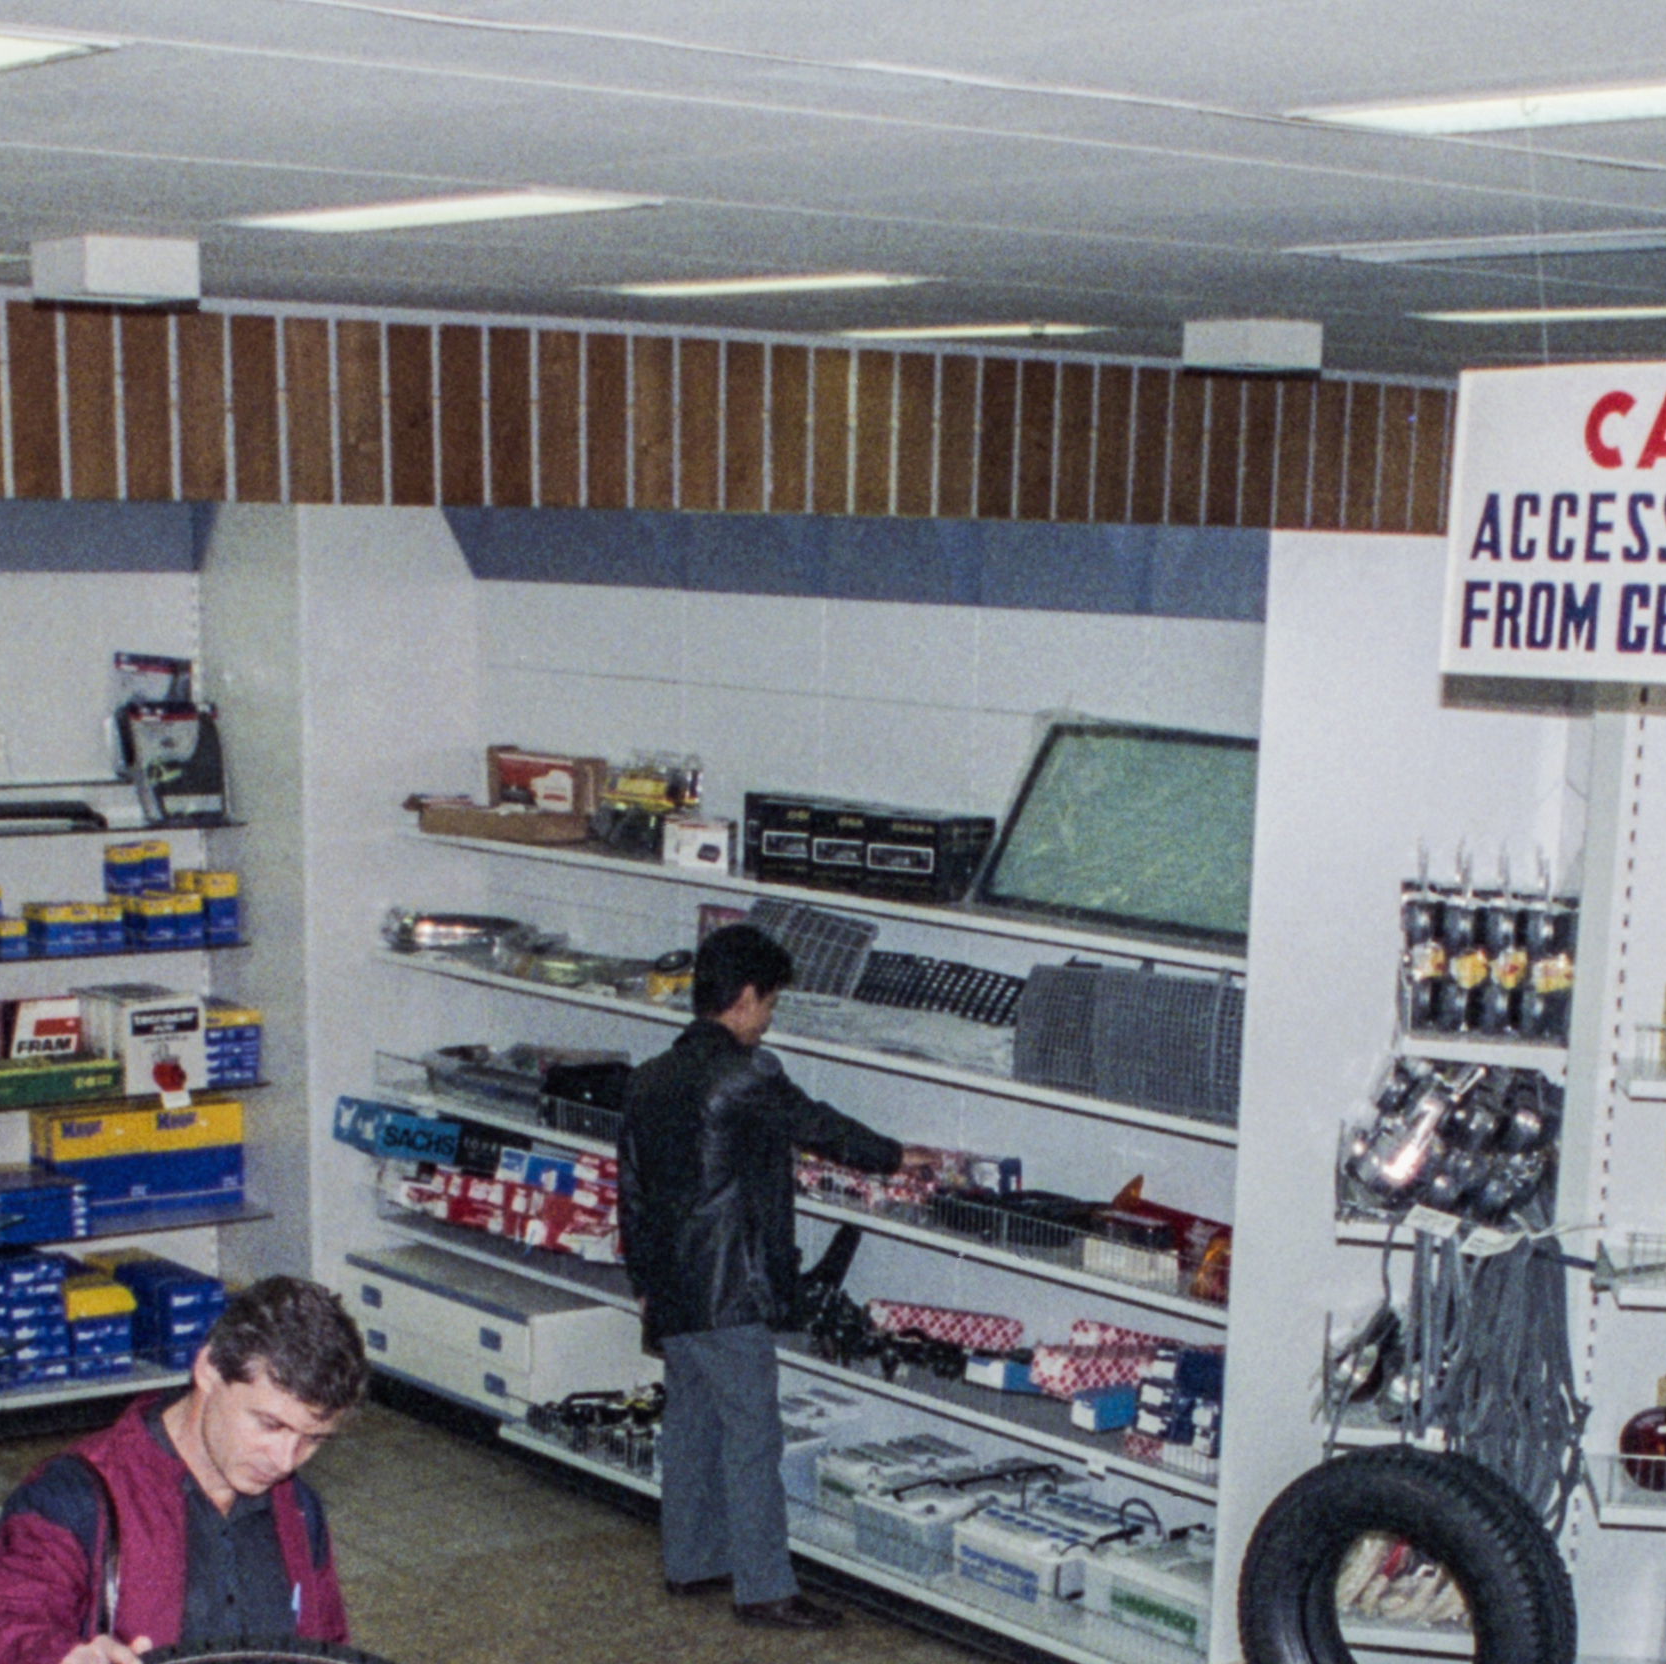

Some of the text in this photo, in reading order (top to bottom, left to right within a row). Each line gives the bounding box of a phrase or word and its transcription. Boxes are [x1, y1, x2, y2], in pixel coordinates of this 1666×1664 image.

[1459, 580, 1601, 652] FROM
[16, 1036, 73, 1054] FRAM
[383, 1124, 456, 1157] SACHS
